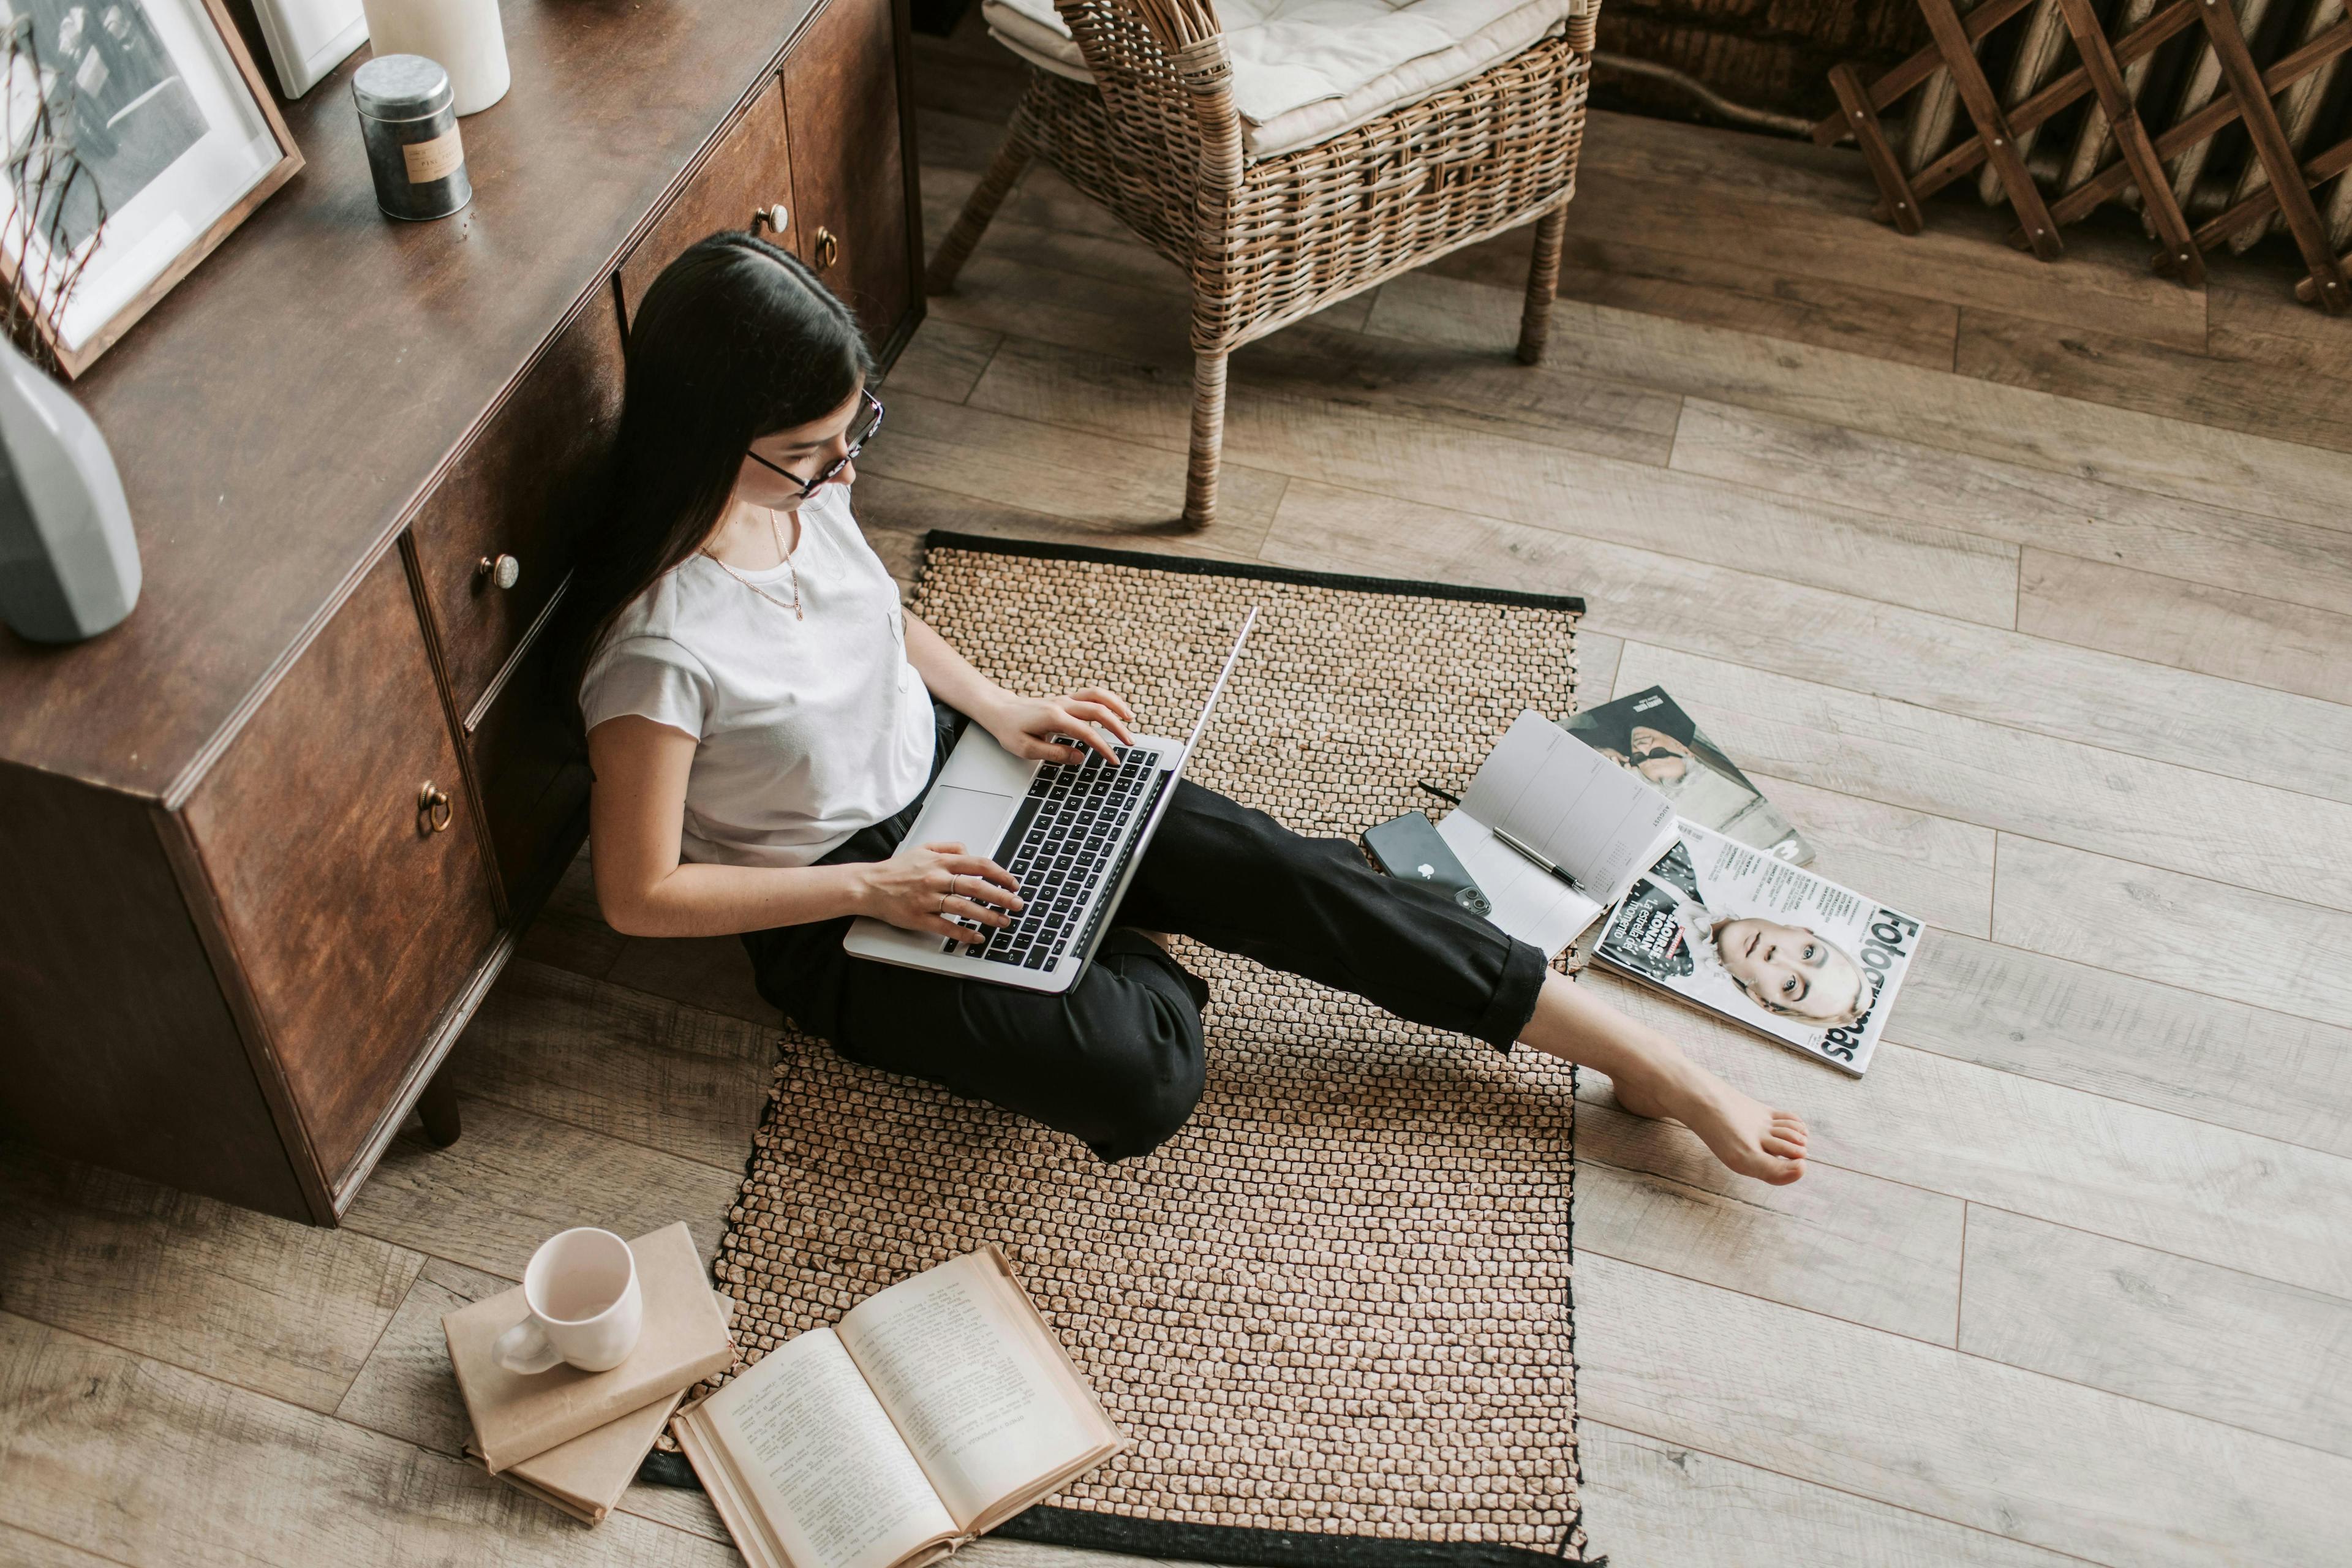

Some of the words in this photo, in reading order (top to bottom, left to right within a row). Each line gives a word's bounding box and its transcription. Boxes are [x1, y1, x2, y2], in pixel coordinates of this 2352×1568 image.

[1652, 803, 1670, 828] AUGUST
[1815, 892, 1826, 911] ROCKWELL
[1612, 899, 1640, 941] momento
[1628, 908, 1653, 940] estrella
[1638, 909, 1667, 952] RONAN
[1621, 935, 1640, 954] del
[1003, 1412, 1024, 1428] ОТЧЕГО
